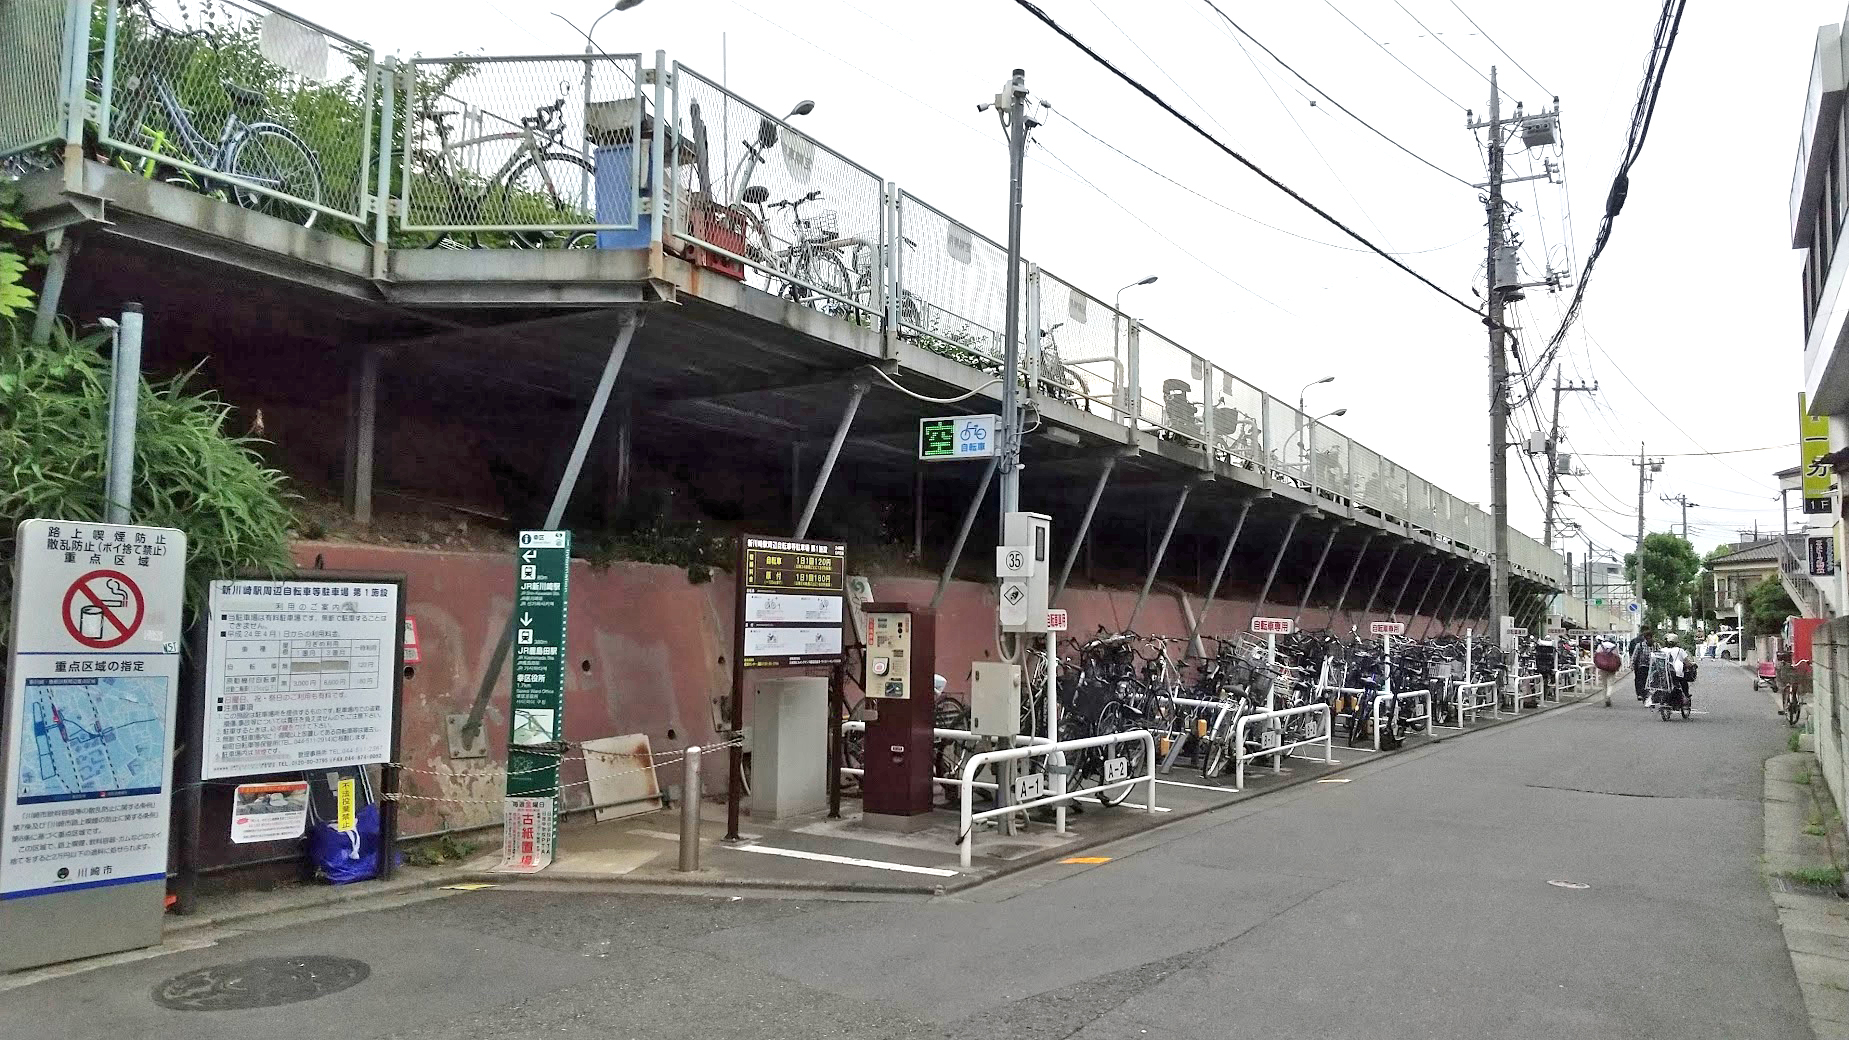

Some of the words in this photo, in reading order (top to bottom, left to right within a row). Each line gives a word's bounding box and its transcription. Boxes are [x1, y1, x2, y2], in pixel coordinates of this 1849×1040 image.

[925, 422, 954, 456] 空
[960, 443, 986, 453] 自転車
[48, 527, 166, 545] 路上喫煙防止
[64, 551, 150, 567] 重点区域
[1008, 553, 1021, 568] 35
[222, 585, 349, 597] 新川崎駅周辺自転車等駐車場
[353, 588, 388, 598] 第1施設
[275, 603, 340, 611] 利用のご案内
[1254, 620, 1289, 632] 自転車専用
[55, 661, 145, 673] 重点区域の指定
[1108, 761, 1124, 778] A-2
[1020, 778, 1039, 798] A-1
[78, 865, 113, 878] 川崎市
